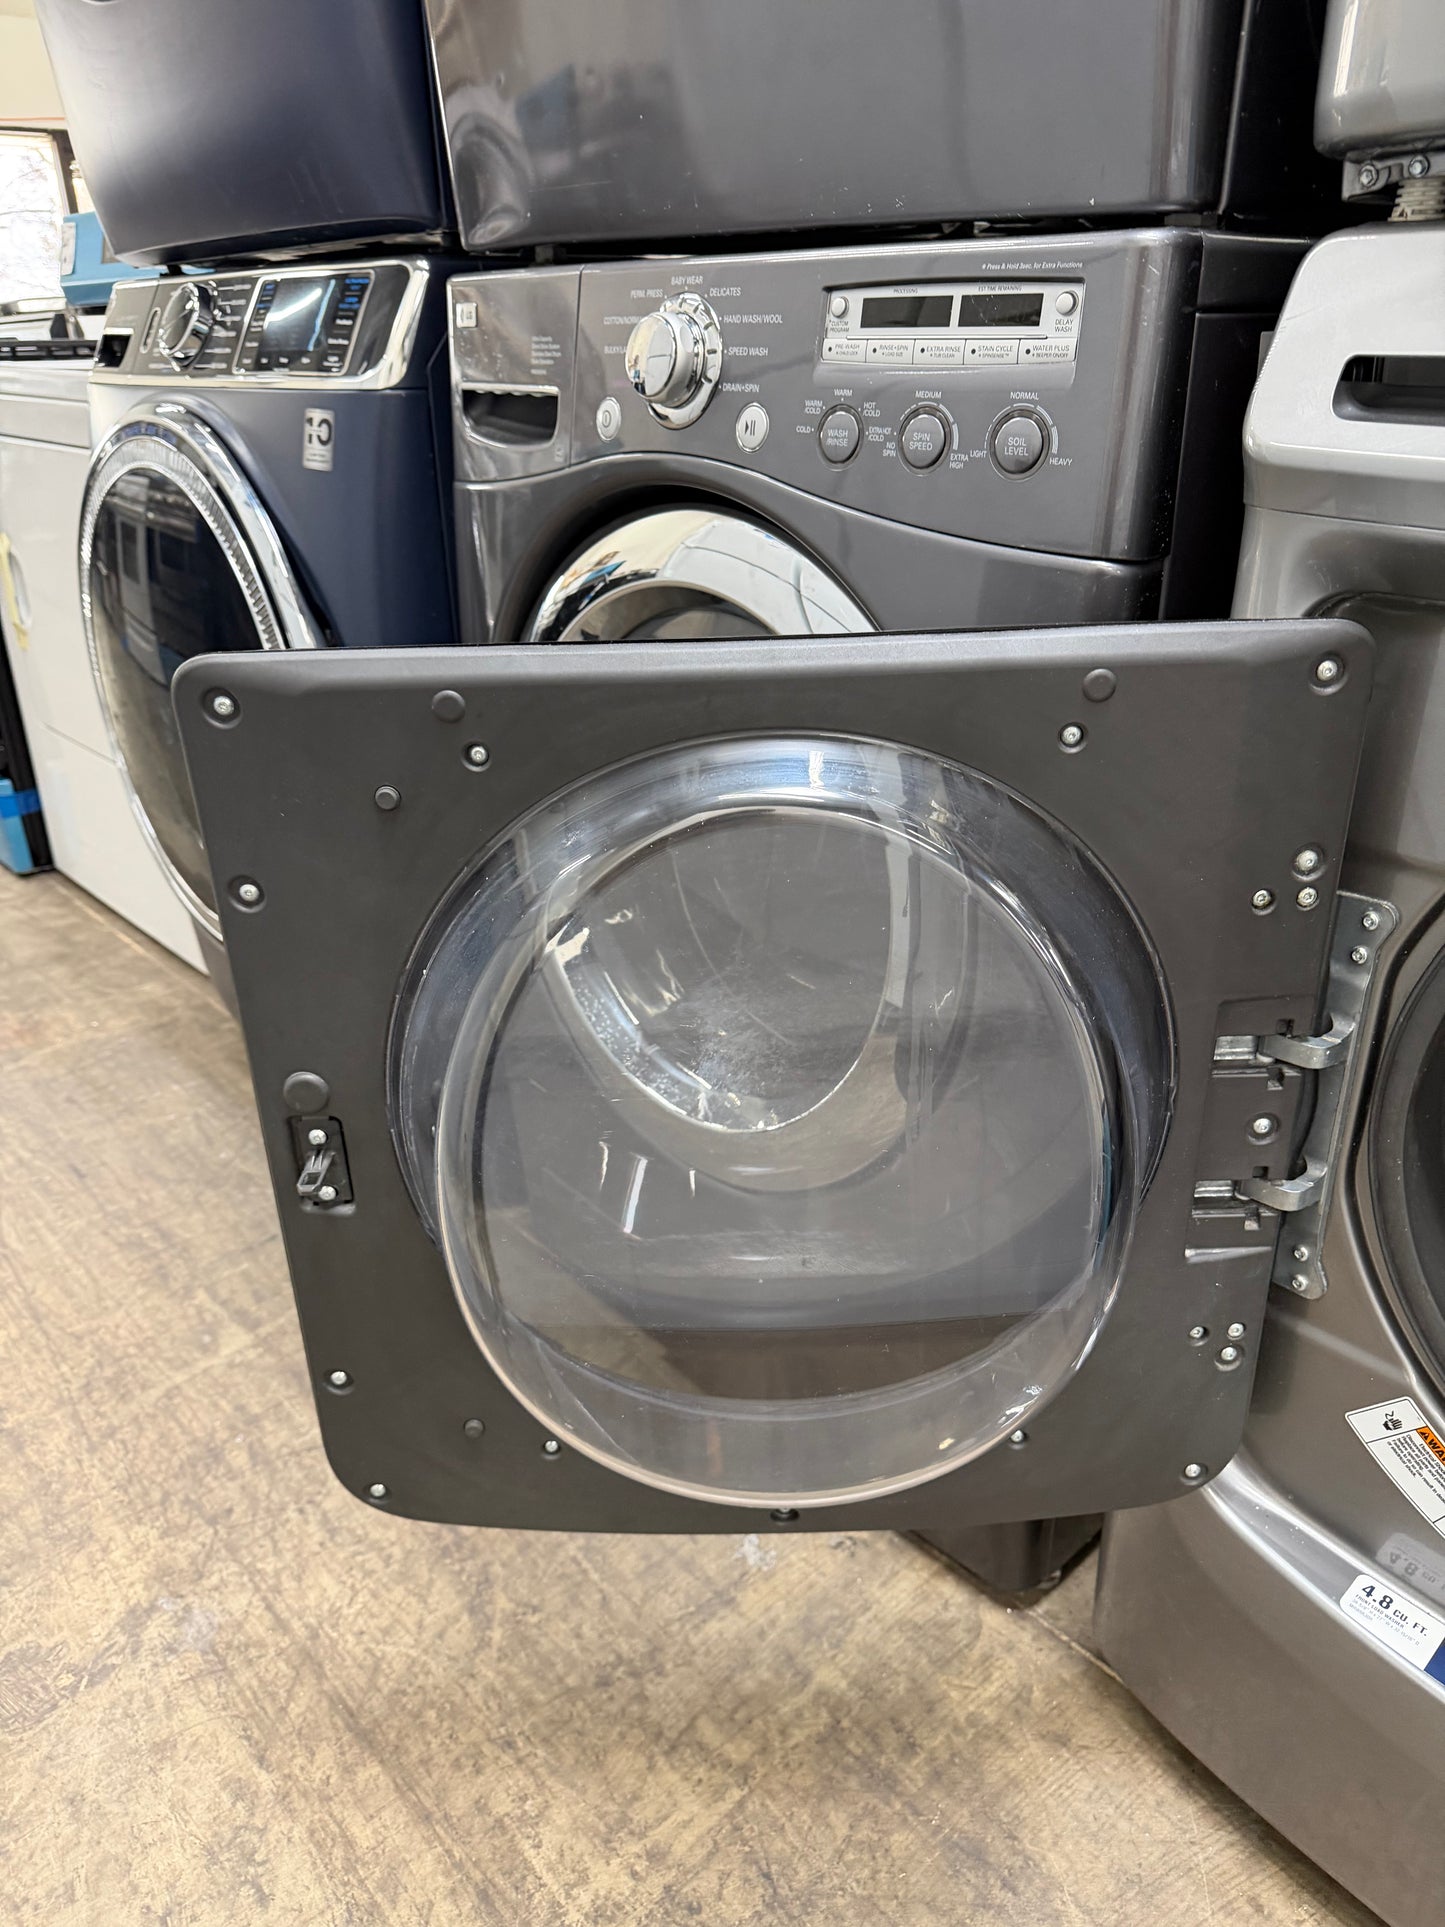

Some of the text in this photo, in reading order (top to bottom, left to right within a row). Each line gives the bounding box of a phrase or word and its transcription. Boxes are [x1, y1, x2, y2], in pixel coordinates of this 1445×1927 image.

[671, 276, 703, 285] BABY WEAR
[646, 289, 663, 297] PRESS
[710, 287, 741, 296] DELICATES
[723, 314, 783, 323] HAND WASH/WOOL
[728, 348, 768, 356] SPEED WASH
[1010, 392, 1039, 400] NORMAL
[828, 429, 848, 438] WASH
[913, 432, 930, 441] SPIN
[826, 438, 848, 447] /RINSE
[909, 441, 932, 451] SPEED
[1008, 437, 1026, 446] SOIL
[1004, 447, 1029, 456] LEVEL
[950, 453, 968, 462] EXTRA
[1050, 458, 1072, 466] HEAVY
[1355, 1594, 1371, 1606] FRONT
[1371, 1605, 1384, 1615] LOAD
[1384, 1613, 1404, 1629] WASHER
[1362, 1585, 1427, 1636] 4.8 CU. FT.
